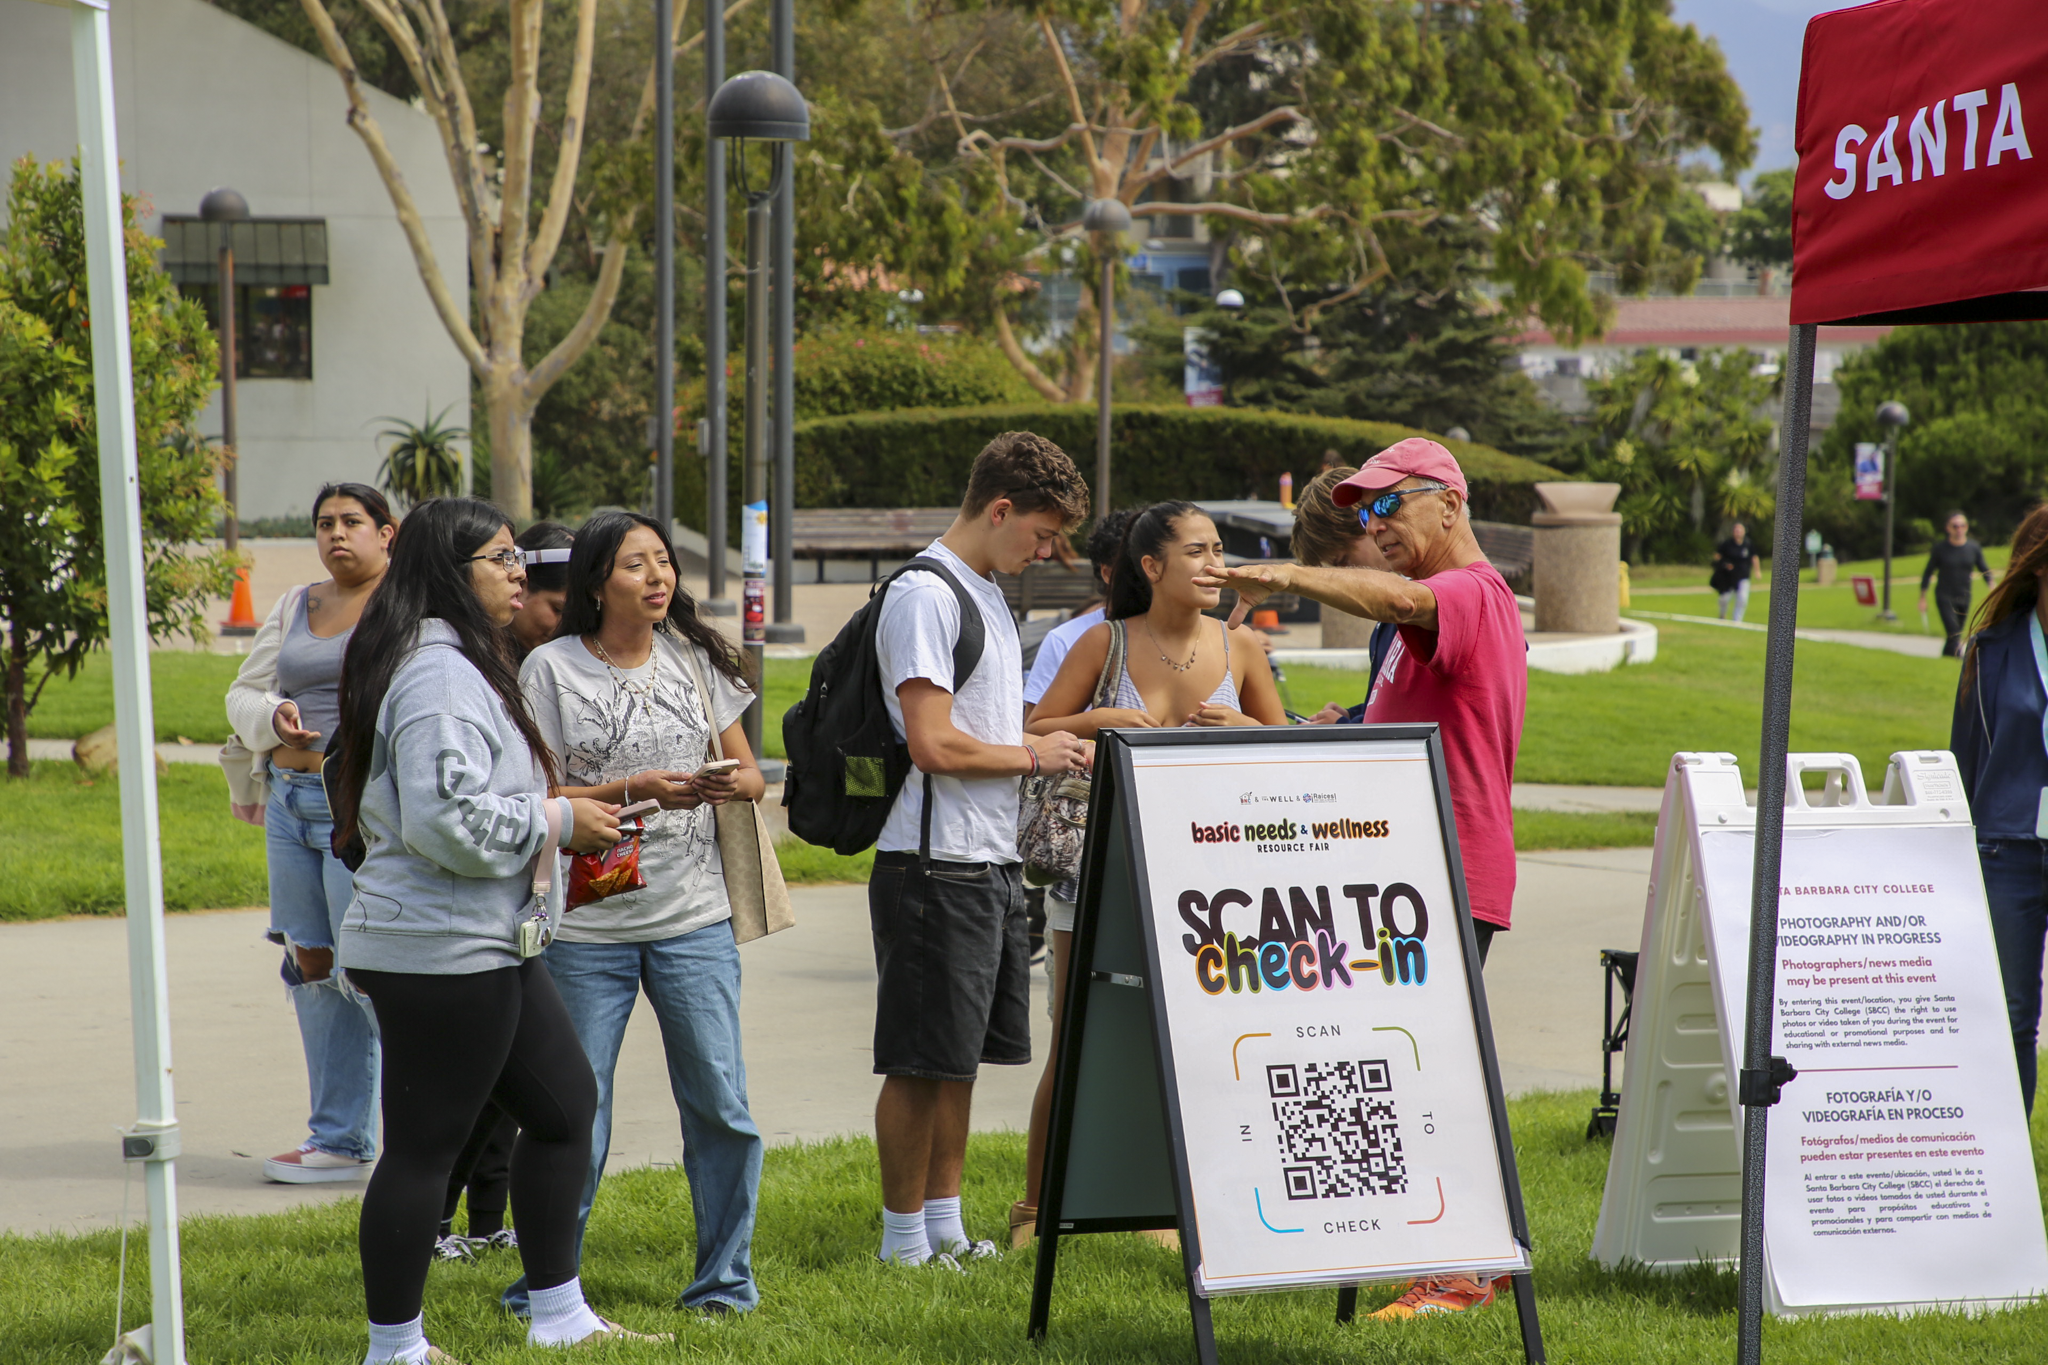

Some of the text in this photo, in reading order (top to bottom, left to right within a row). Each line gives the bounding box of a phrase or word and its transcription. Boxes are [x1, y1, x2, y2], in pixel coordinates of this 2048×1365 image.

[1823, 82, 2033, 200] SANTA
[1191, 818, 1390, 844] basic needs & wellness
[1257, 842, 1330, 853] RESOURCE FAIR
[1795, 886, 1850, 895] BARBARA
[1854, 885, 1878, 894] CITY
[1883, 884, 1935, 894] COLLEGE
[1178, 882, 1429, 956] SCAN TO
[1779, 915, 1927, 930] PHOTOGRAPHY AND/OR
[1861, 934, 1875, 945] IN
[1877, 932, 1942, 944] PROGRESS
[1195, 927, 1429, 995] check-in
[1782, 956, 1932, 972] Photographers/news media
[1787, 973, 1937, 988] may be present at this event
[1779, 999, 1788, 1007] By
[1792, 998, 1822, 1007] entering
[1841, 996, 1895, 1004] event/location,
[1915, 995, 1931, 1004] give
[1934, 994, 1955, 1002] Santa
[1815, 1008, 1829, 1017] City
[1834, 1007, 1861, 1016] College
[1865, 1006, 1890, 1016] (SBCC)
[1910, 1005, 1928, 1015] right
[1782, 1020, 1807, 1029] photos
[1840, 1018, 1861, 1026] taken
[1863, 1017, 1870, 1025] of
[1887, 1017, 1911, 1026] during
[1912, 1016, 1924, 1024] the
[1947, 1015, 1958, 1023] for
[1296, 1024, 1341, 1038] SCAN
[1784, 1029, 1825, 1038] educational
[1844, 1028, 1888, 1038] promotional
[1893, 1029, 1925, 1037] purposes
[1930, 1026, 1944, 1034] and
[1949, 1026, 1960, 1034] for
[1786, 1041, 1813, 1050] sharing
[1814, 1040, 1830, 1048] with
[1832, 1039, 1862, 1047] external
[1883, 1038, 1908, 1046] media.
[1826, 1087, 1932, 1104] FOTOGRAFÍA Y/O
[1802, 1106, 1964, 1123] VIDEOGRAFÍA EN PROCESO
[1422, 1111, 1435, 1135] TO
[1239, 1124, 1252, 1142] IN
[1801, 1132, 1976, 1148] Fotógrafos/medios de comunicación
[1800, 1150, 1837, 1164] pueden
[1839, 1151, 1864, 1160] estar
[1866, 1150, 1913, 1162] presentes
[1929, 1148, 1948, 1157] este
[1951, 1147, 1984, 1156] evento
[1804, 1173, 1812, 1181] Al
[1866, 1170, 1930, 1179] evento/ubicación,
[1933, 1168, 1952, 1176] usted
[1955, 1168, 1962, 1176] le
[1829, 1183, 1860, 1191] Barbara
[1862, 1182, 1876, 1191] City
[1878, 1181, 1905, 1191] College
[1908, 1180, 1933, 1190] (SBCC)
[1944, 1179, 1973, 1187] derecho
[1976, 1178, 1985, 1186] de
[1854, 1193, 1878, 1201] videos
[1880, 1192, 1912, 1200] tomados
[1926, 1191, 1946, 1199] usted
[1948, 1190, 1978, 1198] durante
[1879, 1203, 1917, 1213] propósitos
[1931, 1201, 1971, 1209] educativos
[1811, 1216, 1864, 1227] promocionales
[1896, 1213, 1932, 1223] compartir
[1953, 1211, 1979, 1219] medios
[1982, 1210, 1992, 1218] de
[1323, 1219, 1381, 1234] CHECK
[1813, 1227, 1861, 1236] comunicación
